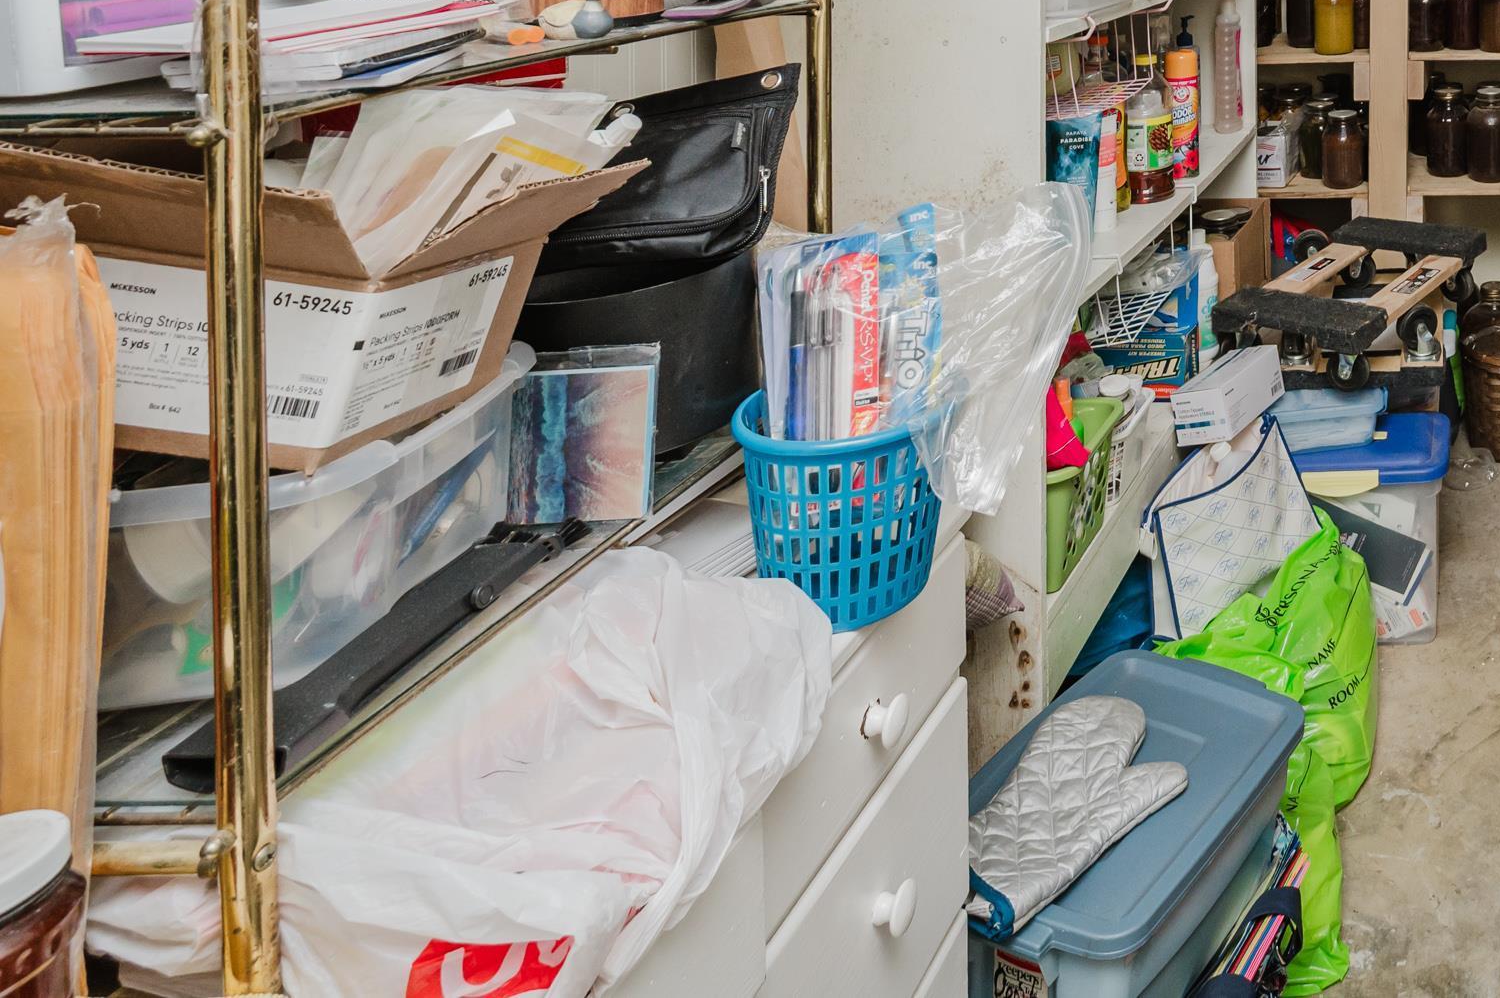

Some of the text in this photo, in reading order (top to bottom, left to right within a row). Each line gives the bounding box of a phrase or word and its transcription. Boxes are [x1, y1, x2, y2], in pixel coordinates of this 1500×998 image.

[1060, 136, 1093, 144] PARADISE
[468, 264, 509, 288] 61-59245
[860, 268, 874, 314] Pentel
[272, 291, 355, 316] 61-59245
[156, 314, 195, 331] Strips
[130, 339, 150, 350] yds
[187, 345, 200, 357] 12
[369, 329, 401, 348] Packing
[285, 384, 324, 397] 61-59245
[1327, 674, 1361, 710] ROOM
